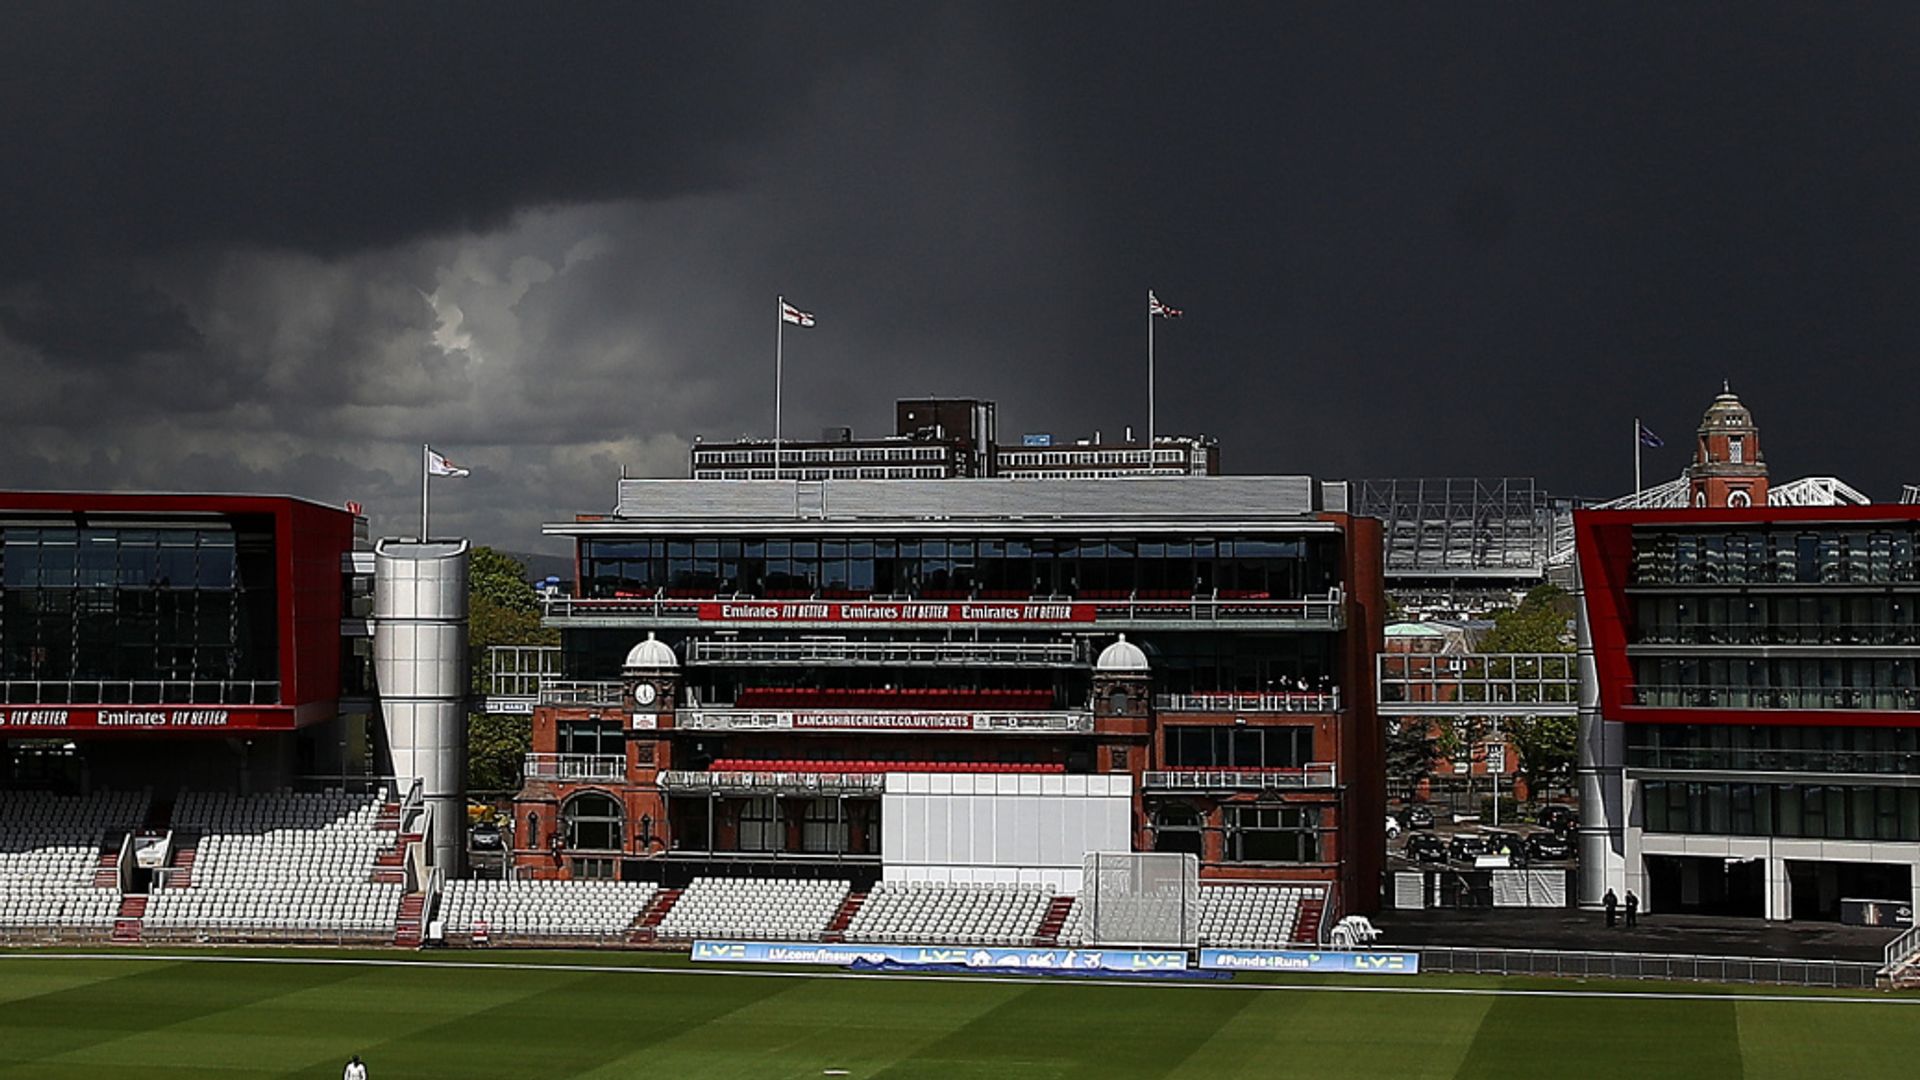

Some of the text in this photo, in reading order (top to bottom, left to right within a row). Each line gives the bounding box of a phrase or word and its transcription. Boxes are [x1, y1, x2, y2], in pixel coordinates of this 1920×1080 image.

[722, 605, 828, 619] Emirates FLY BETTER
[841, 605, 948, 619] Emirates FLY BETTER
[962, 605, 1071, 619] Emirates FLY BETTER
[11, 711, 29, 725] FLY
[30, 711, 68, 725] BETTER
[97, 710, 228, 725] Emirates FLY BETTER
[797, 715, 969, 728] LANCASHIRECRICKET.CO.UK/TICKETS
[1217, 954, 1309, 968] #Funds4Runs
